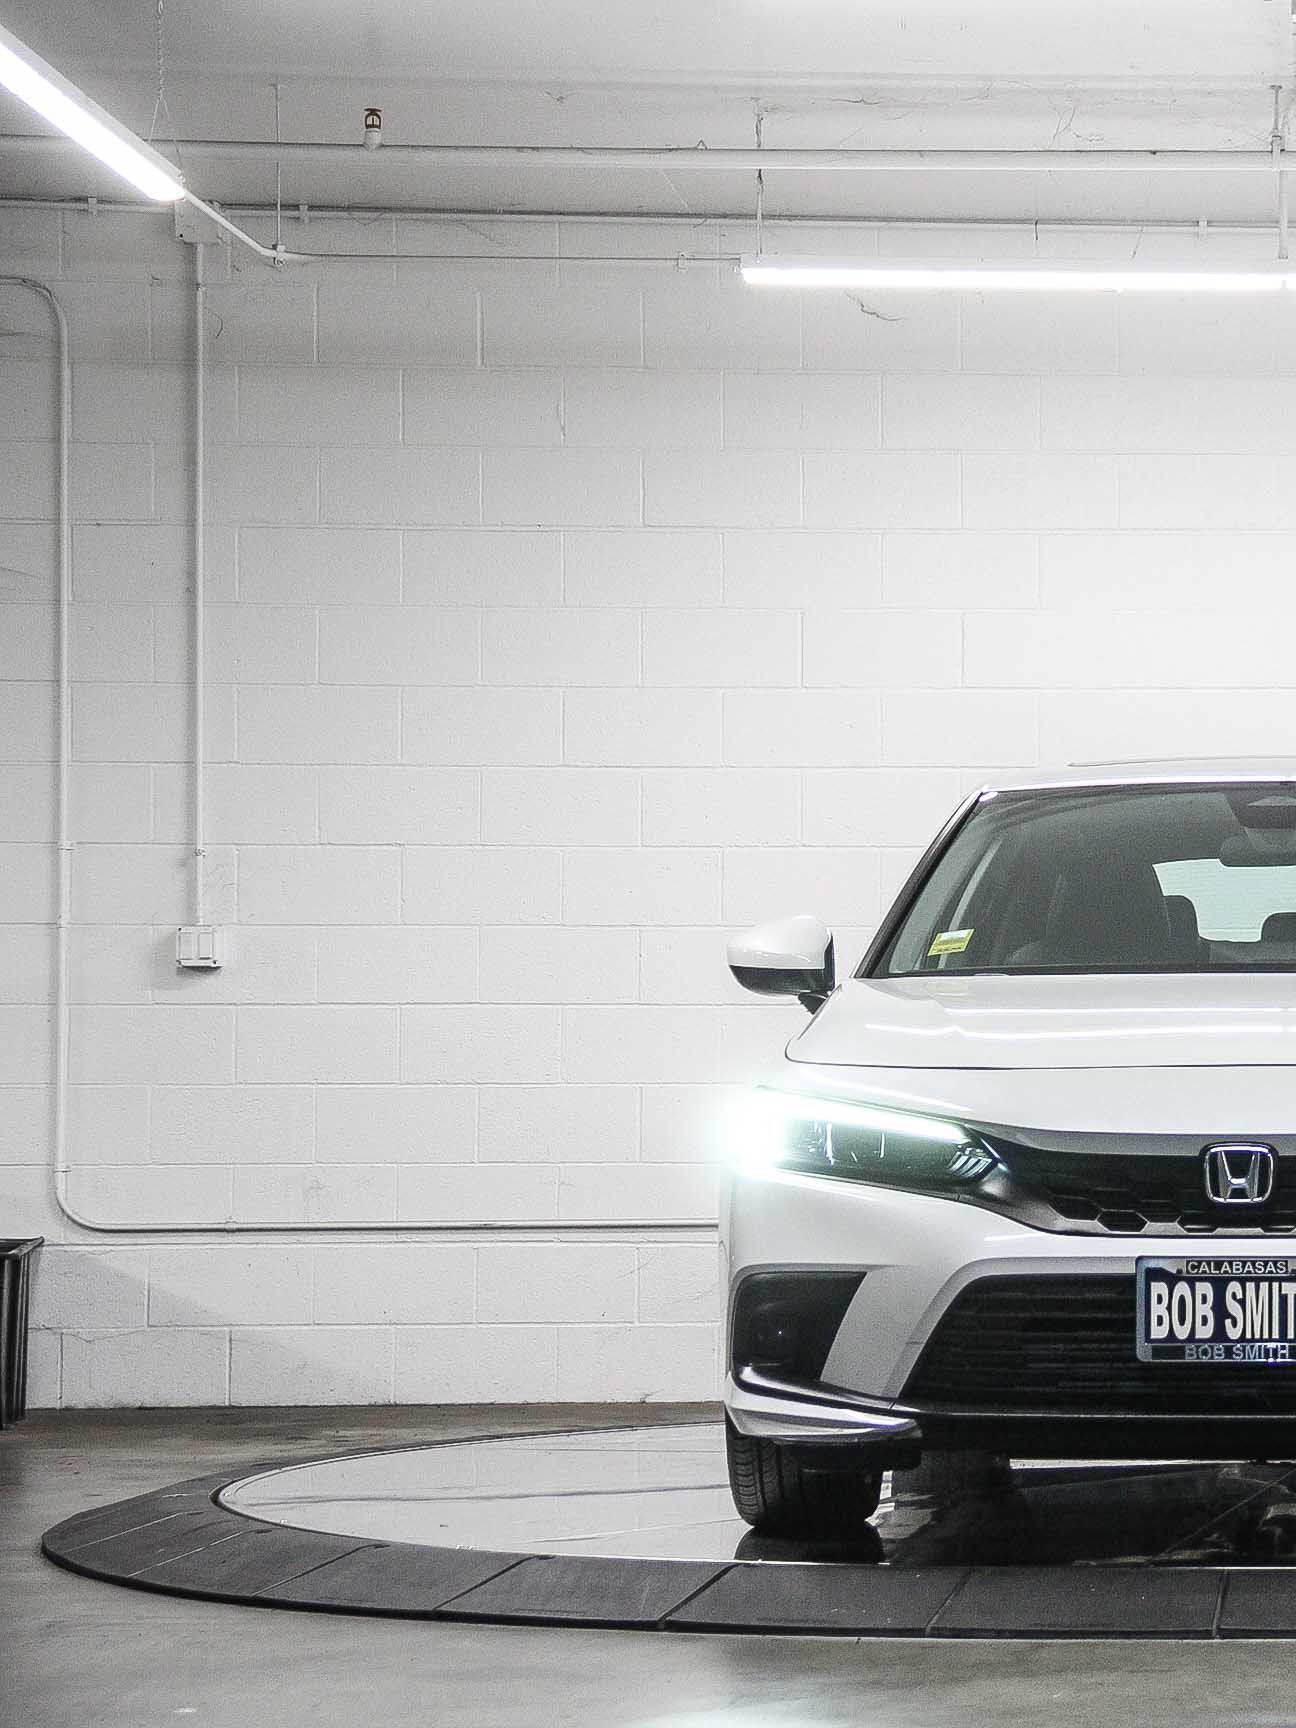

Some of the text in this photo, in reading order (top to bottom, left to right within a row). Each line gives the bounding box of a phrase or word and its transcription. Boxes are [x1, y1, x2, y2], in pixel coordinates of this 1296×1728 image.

[1187, 1261, 1287, 1275] CALABASAS
[1150, 1281, 1214, 1340] BOB
[1185, 1344, 1289, 1360] BOB SMITH
